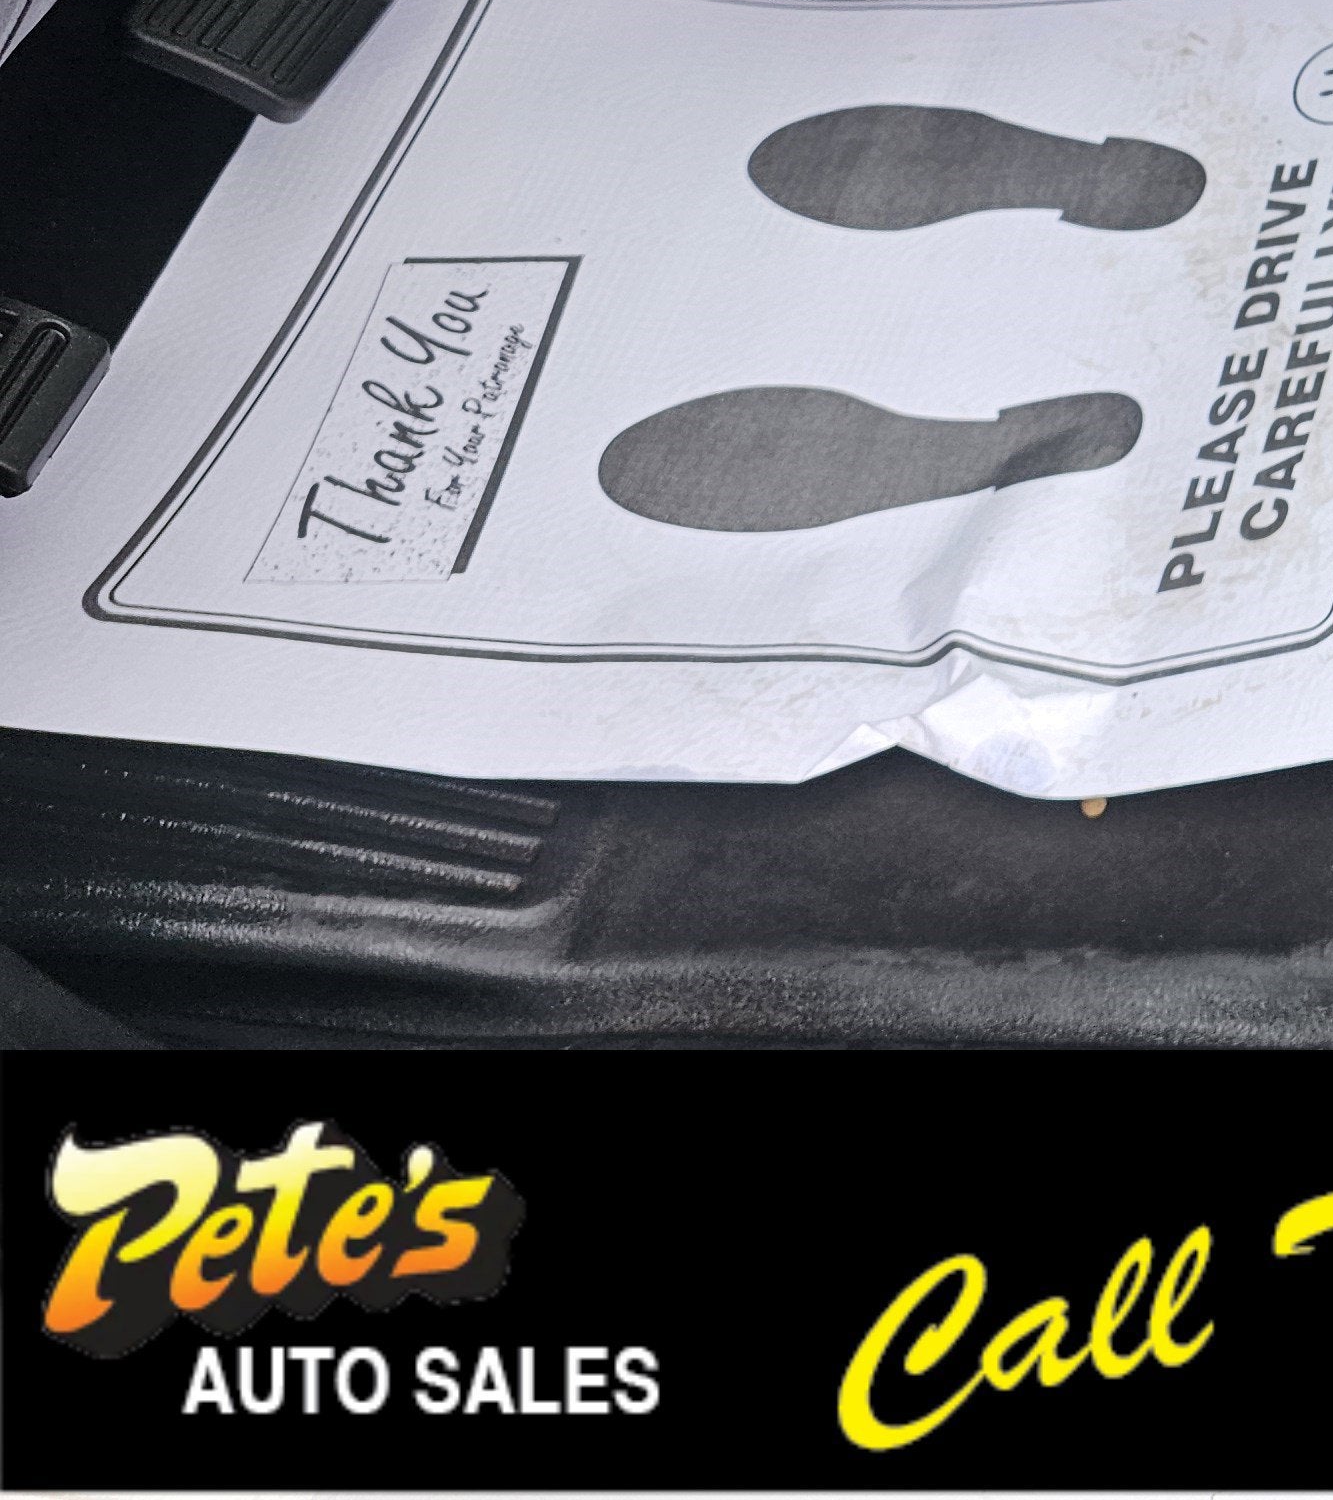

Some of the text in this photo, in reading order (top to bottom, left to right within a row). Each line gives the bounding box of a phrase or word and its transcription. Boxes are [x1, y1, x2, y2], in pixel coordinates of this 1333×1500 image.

[297, 289, 490, 544] Thank You
[424, 322, 534, 511] For Your Patronage
[1157, 158, 1319, 593] PLEASE DRIVE
